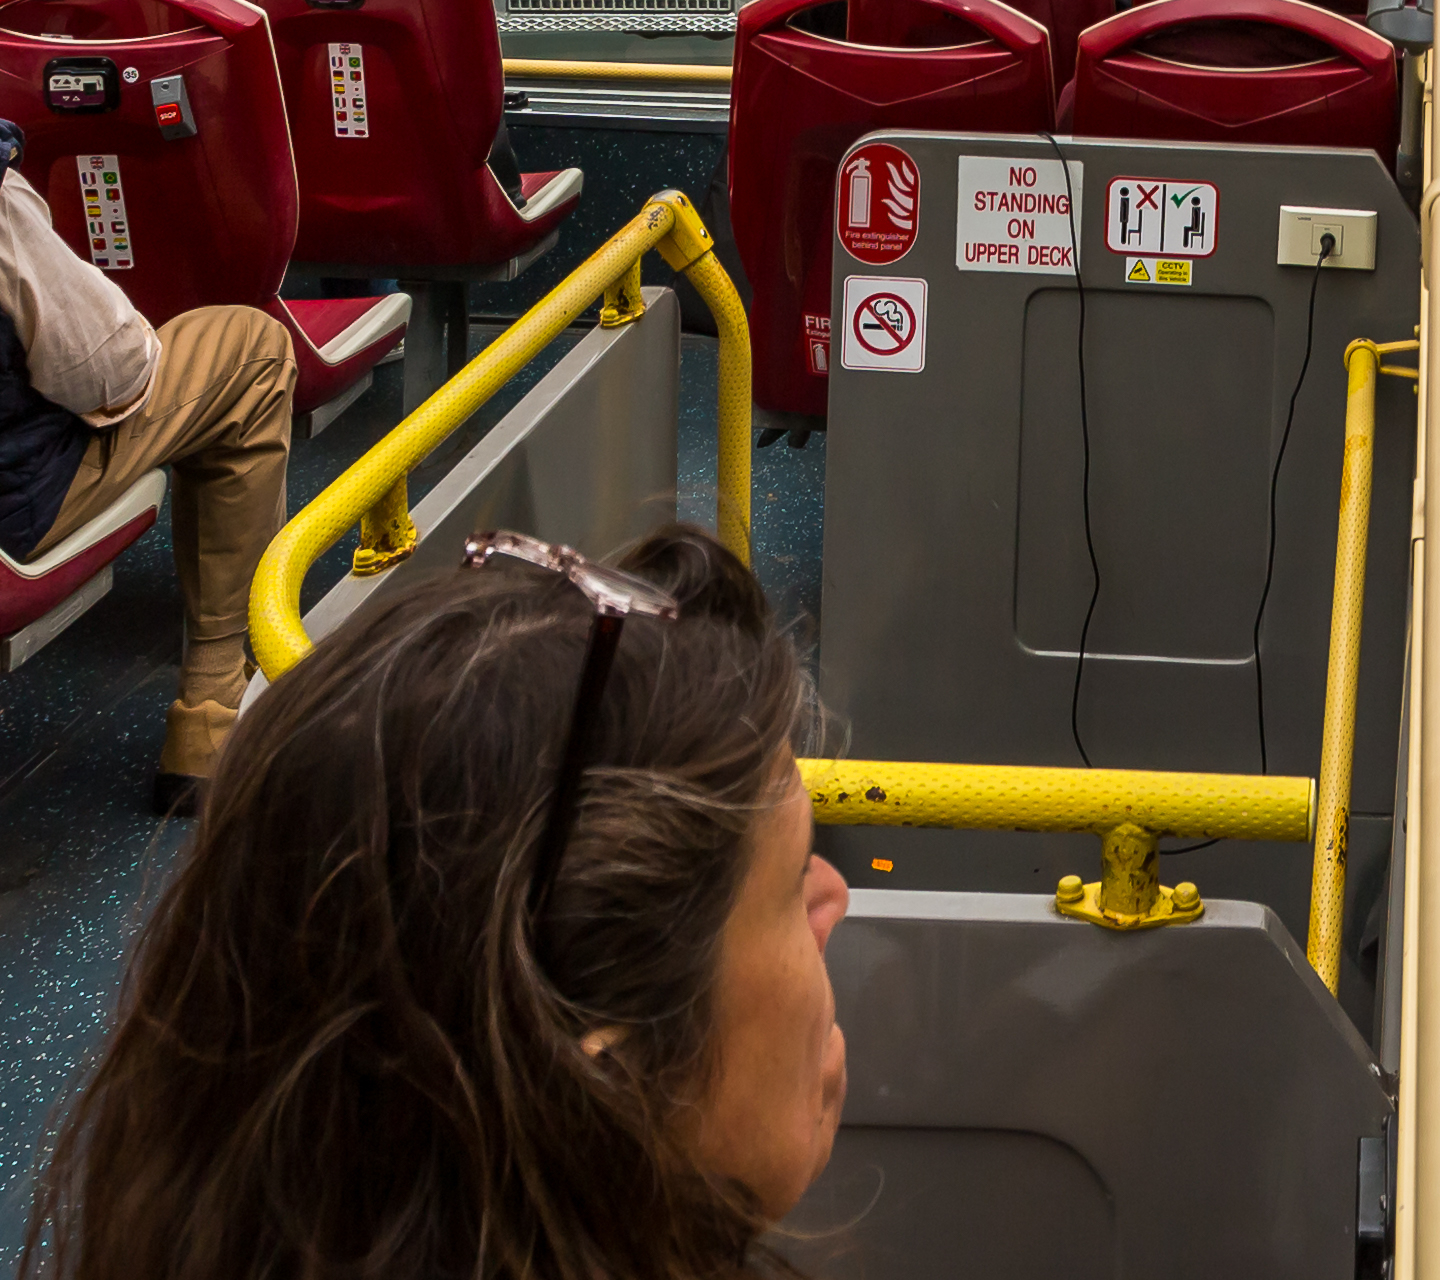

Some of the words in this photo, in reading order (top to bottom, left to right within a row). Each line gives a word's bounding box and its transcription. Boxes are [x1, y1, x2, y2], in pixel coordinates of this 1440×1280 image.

[123, 70, 138, 80] 35
[160, 111, 177, 120] STOP
[1009, 167, 1038, 187] NO
[974, 191, 1071, 215] STANDING
[1007, 218, 1036, 239] ON
[845, 230, 860, 239] Fire
[862, 231, 909, 242] extinguisher
[852, 240, 879, 250] behind
[880, 242, 903, 251] panel
[965, 243, 1019, 265] UPPER
[1028, 246, 1072, 267] DECK
[1161, 262, 1185, 270] CCTV
